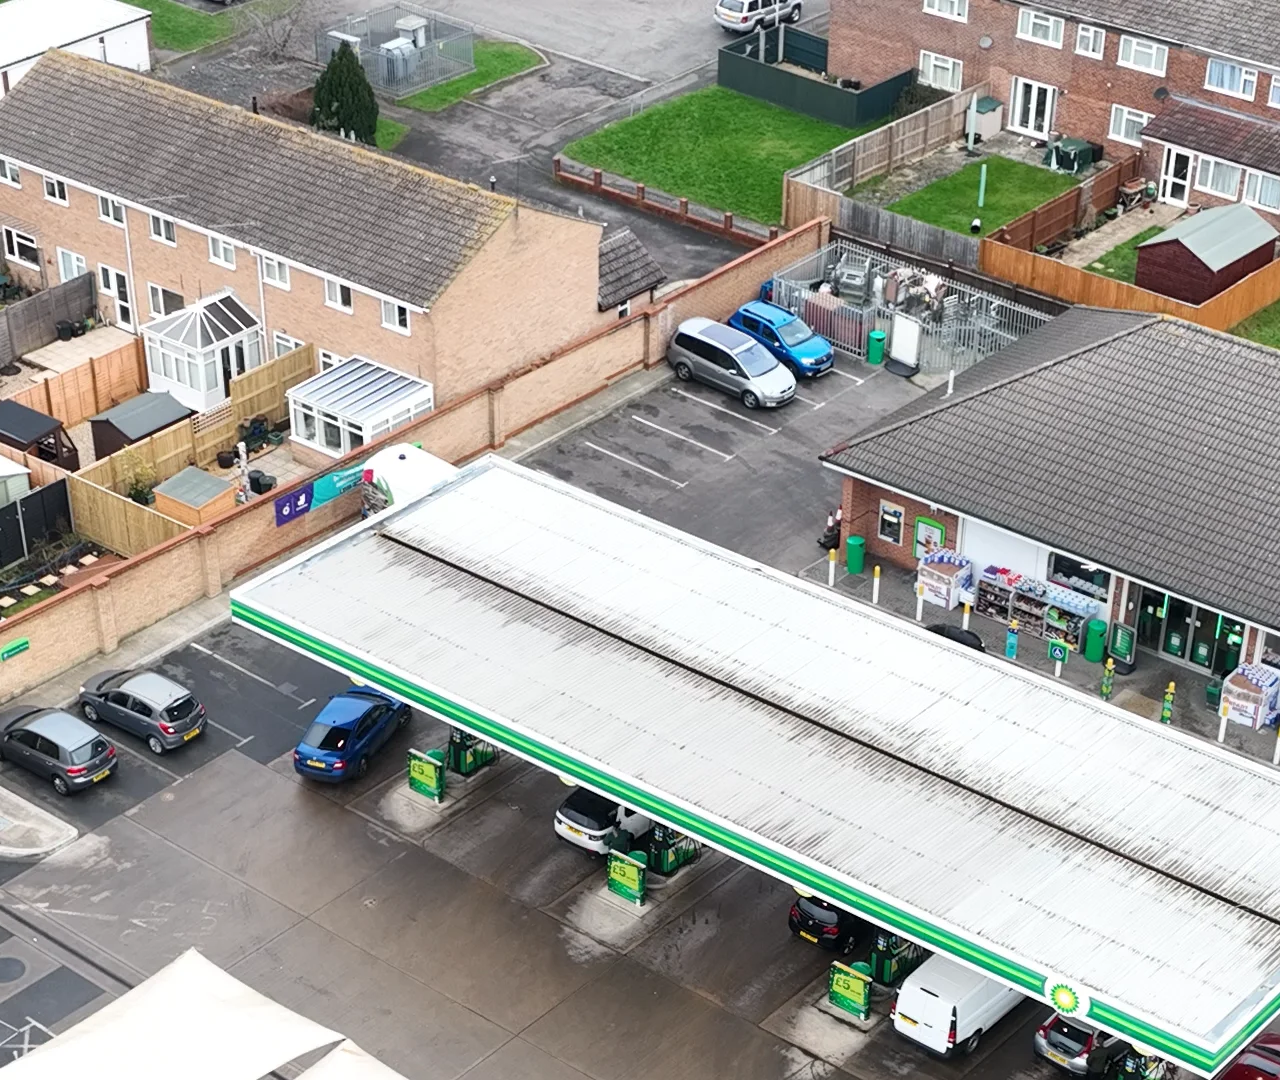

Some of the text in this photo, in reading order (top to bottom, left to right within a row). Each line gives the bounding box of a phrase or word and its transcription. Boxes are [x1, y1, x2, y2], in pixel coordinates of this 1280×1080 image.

[412, 762, 425, 776] £5
[612, 864, 627, 877] £5
[835, 976, 851, 991] £5
